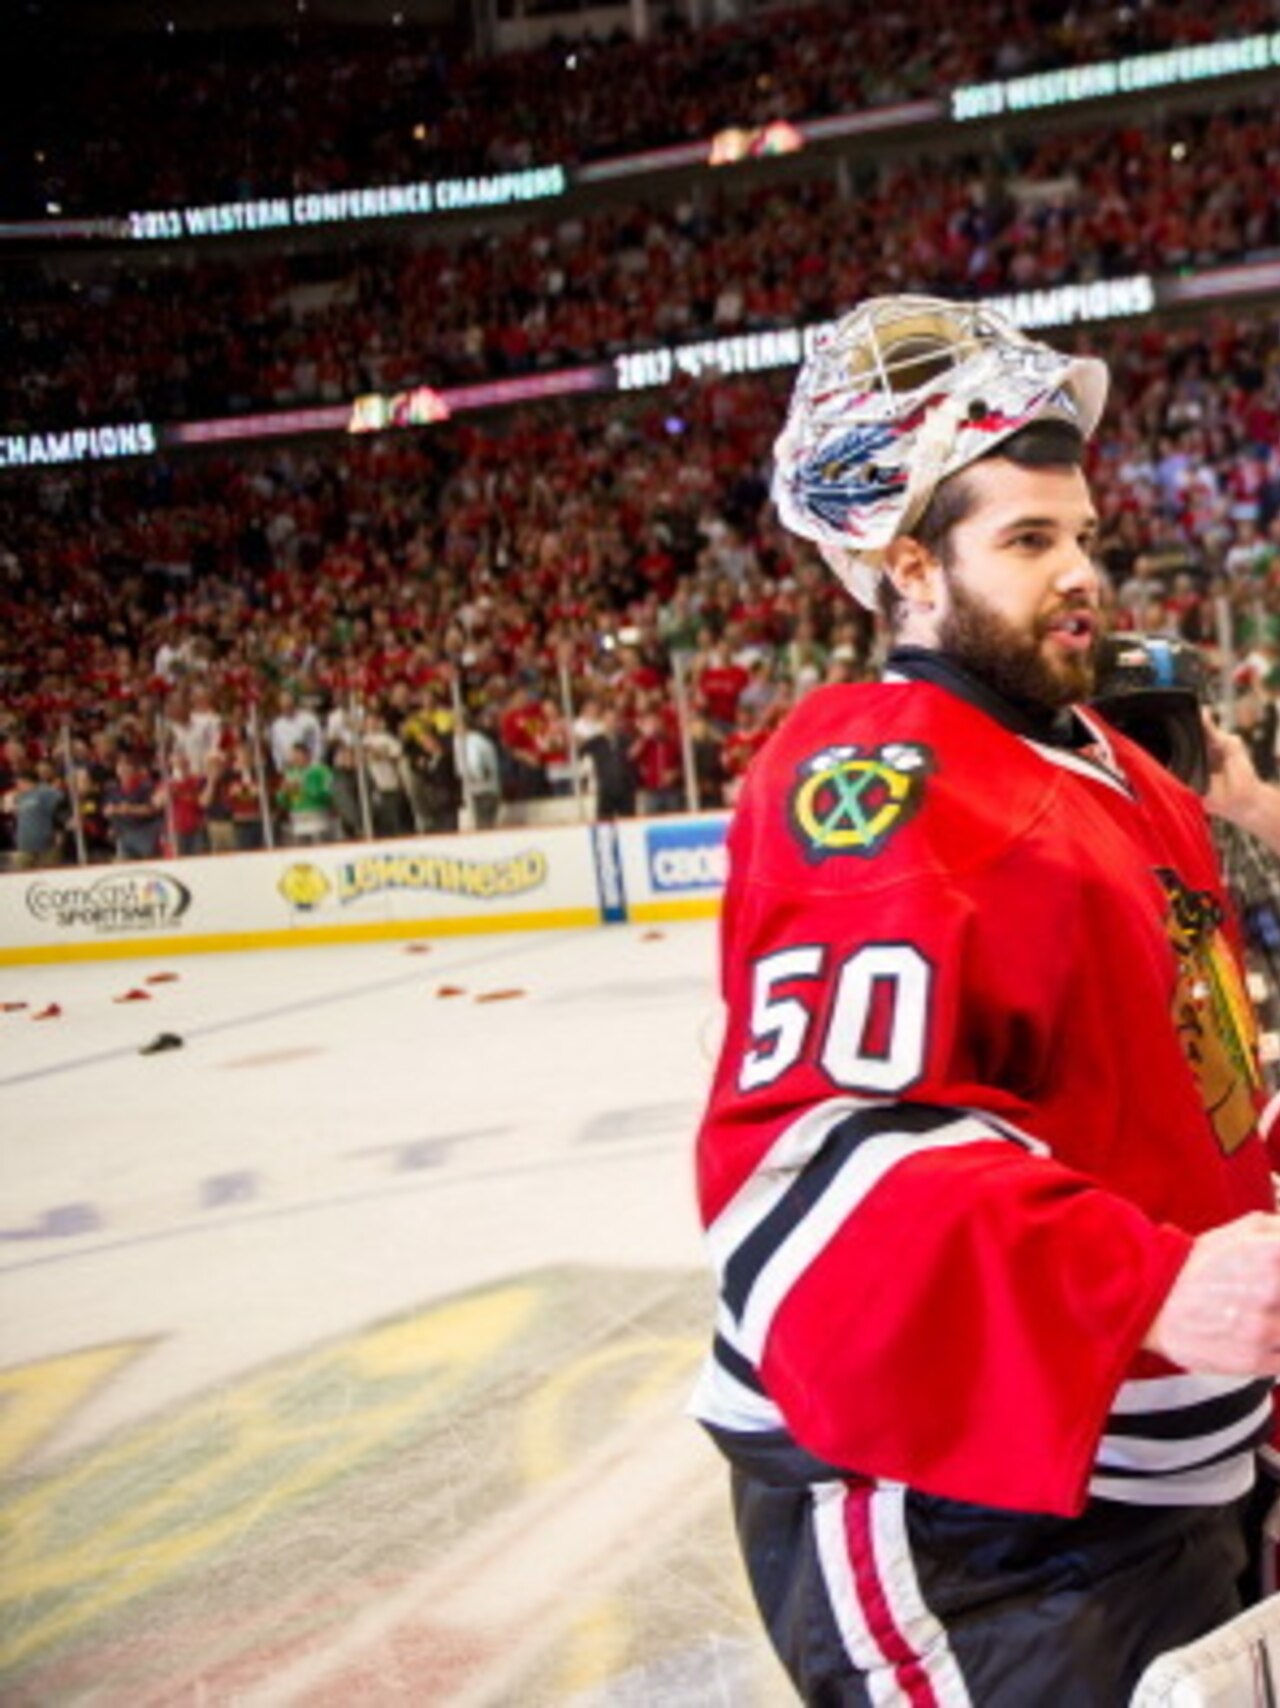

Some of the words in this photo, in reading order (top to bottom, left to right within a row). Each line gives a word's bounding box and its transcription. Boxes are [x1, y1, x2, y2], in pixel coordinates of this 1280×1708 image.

[1005, 63, 1117, 110] WESTERN
[1118, 35, 1269, 91] CONFERENCE
[129, 211, 182, 239] 2013
[184, 199, 291, 235] WESTERN
[293, 182, 432, 224] CONFERENCE
[435, 164, 565, 209] CHAMPIONS
[984, 275, 1154, 329] HAMPIONS
[736, 941, 938, 1095] 50
